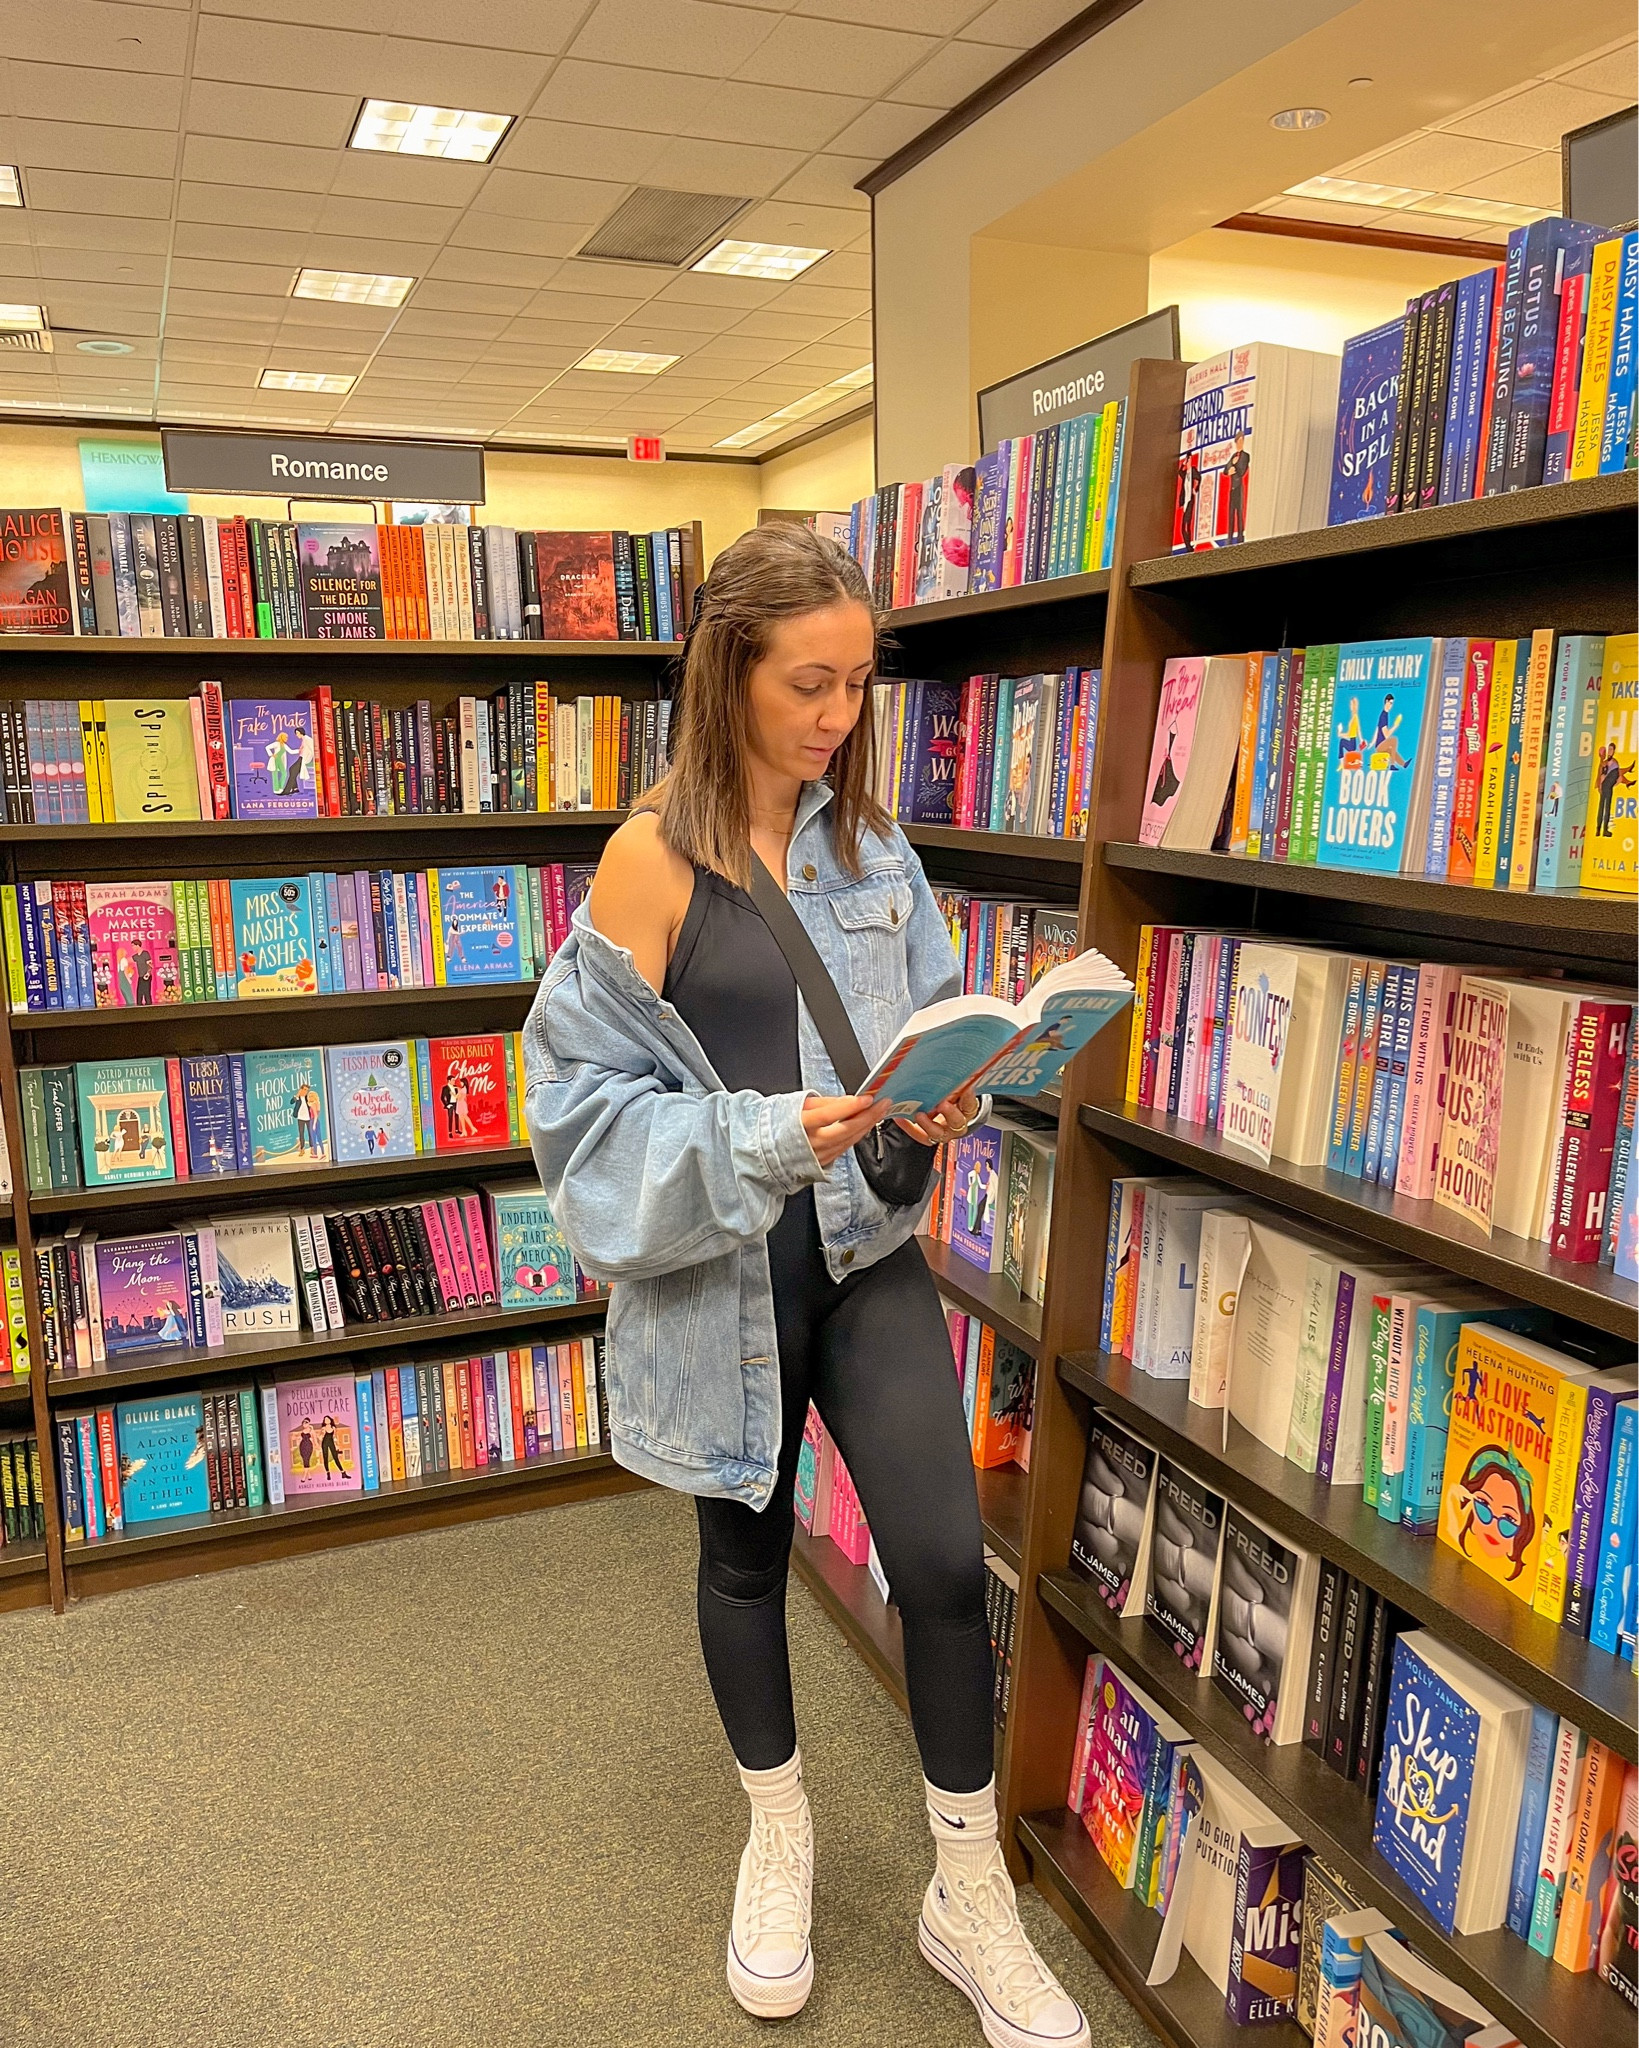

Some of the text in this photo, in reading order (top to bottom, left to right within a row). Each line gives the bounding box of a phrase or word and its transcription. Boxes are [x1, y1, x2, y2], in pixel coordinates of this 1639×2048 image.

[1523, 264, 1543, 338] LOTUS
[1496, 246, 1522, 400] STILL BEATING
[1593, 261, 1617, 383] DAISY HAITES
[1615, 305, 1634, 377] HAITES
[1033, 370, 1105, 416] Romance
[1354, 374, 1400, 419] BACK
[1183, 389, 1223, 428] HUSBAND
[1197, 408, 1252, 446] MATERIAL
[1360, 409, 1389, 443] IN A
[634, 438, 660, 460] EXIT
[1342, 435, 1393, 478] SPEL
[271, 454, 388, 482] Romance
[74, 519, 91, 585] INFECTED
[160, 530, 171, 573] COMFORT
[167, 525, 178, 564] CARRION
[234, 515, 248, 576] NIGHTWING
[309, 578, 377, 592] SILENCE FOR
[560, 573, 597, 581] DRACULA
[320, 593, 368, 606] THE DEAD
[621, 594, 634, 633] Dracul
[0, 607, 69, 626] HEPHERD
[324, 612, 368, 624] SIMONE
[318, 626, 376, 639] ST. JAMES
[1340, 654, 1423, 682] EMILY HENRY
[1160, 678, 1198, 726] Thread
[1611, 680, 1638, 699] TAKE
[254, 705, 271, 720] The
[537, 683, 549, 748] SUNDIAL
[1527, 643, 1548, 769] GEORGETTE HEYER
[238, 711, 307, 739] Fake Mate
[1437, 676, 1454, 778] BEACH READ
[421, 720, 431, 770] ANCESTOR
[1552, 706, 1566, 777] EVE BROWN
[1338, 770, 1392, 807] BOOK
[241, 800, 315, 809] LANA FERGUSON
[1482, 767, 1497, 855] FARAH HERON
[1325, 807, 1396, 848] LOVERS
[1592, 858, 1625, 872] TALIA
[90, 891, 128, 899] SARAH
[131, 889, 168, 898] ADAMS
[246, 892, 283, 920] MRS.
[443, 895, 506, 915] American
[460, 891, 474, 899] THE
[96, 907, 164, 918] PRACTICE
[108, 919, 156, 929] MAKES
[444, 912, 498, 922] ROOMMATE
[103, 930, 162, 942] PERFECT
[243, 913, 299, 947] NASH'S
[460, 922, 515, 933] EXPERIMENT
[1044, 923, 1077, 943] WINGS
[258, 938, 307, 970] ASHES
[454, 961, 514, 971] ELENA ARMAS
[1062, 997, 1115, 1011] HENRY
[1345, 967, 1362, 1035] HEART BONES
[1394, 977, 1416, 1052] THIS GIRL
[1459, 992, 1476, 1035] IT
[440, 1044, 494, 1060] TESSA BAILEY
[991, 1050, 1048, 1067] OOK
[1454, 1037, 1499, 1081] WITH
[1513, 1050, 1543, 1066] with Us
[1524, 1043, 1544, 1055] Ends
[1574, 1014, 1598, 1101] HOPELESS
[97, 1066, 151, 1079] ASTRID PARKER
[189, 1061, 220, 1078] TESSA
[342, 1056, 368, 1071] TESSA
[447, 1060, 492, 1080] Chase
[977, 1068, 1043, 1087] VERS
[94, 1078, 157, 1094] DOESN'T FAIL
[189, 1079, 224, 1096] BAILEY
[256, 1070, 316, 1098] HOOK LINE,
[469, 1076, 496, 1096] Me
[266, 1095, 284, 1112] AND
[350, 1102, 399, 1116] the Halls
[352, 1092, 393, 1109] Wreck
[1448, 1081, 1474, 1126] US
[256, 1110, 294, 1132] SINKER
[1229, 1102, 1272, 1150] HOOVER
[1440, 1157, 1494, 1216] HOOVER
[1559, 1136, 1580, 1227] COLLEEN HOOVER
[215, 1224, 289, 1237] MAYA BANKS
[501, 1211, 555, 1226] UNDERTAK
[523, 1231, 547, 1243] HART
[112, 1252, 171, 1275] Hang the
[521, 1248, 552, 1261] MERCY
[124, 1273, 161, 1288] Moon
[307, 1282, 323, 1322] DOMINATED
[225, 1309, 292, 1328] RUSH
[1308, 1311, 1319, 1342] LIES
[1466, 1347, 1555, 1395] HELENA HUNTING
[291, 1387, 342, 1400] DELILAH GREEN
[1480, 1372, 1530, 1415] A LOVE
[125, 1405, 197, 1425] OLIVIE BLAKE
[286, 1399, 349, 1417] DOESN'T CARE
[137, 1434, 189, 1449] ALONE
[1454, 1395, 1552, 1465] CATASTROPHE
[146, 1450, 182, 1462] WITH
[1090, 1427, 1147, 1479] FREED
[143, 1474, 189, 1486] IN THE
[151, 1462, 179, 1473] YOU
[139, 1486, 194, 1502] ETHER
[1159, 1474, 1217, 1528] FREED
[1225, 1522, 1289, 1584] FREED
[1085, 1557, 1121, 1588] JAMES
[1320, 1574, 1335, 1643] FREED
[1405, 1657, 1465, 1719] MOLLY JAMES
[1102, 1714, 1127, 1757] that
[1120, 1711, 1140, 1741] all
[1398, 1692, 1458, 1795] Skip
[1106, 1755, 1125, 1782] we
[1091, 1760, 1126, 1813] never
[1544, 1730, 1573, 1865] NEVER BEEN KISSED
[1395, 1782, 1446, 1874] End
[1248, 2003, 1275, 2020] ELLE
